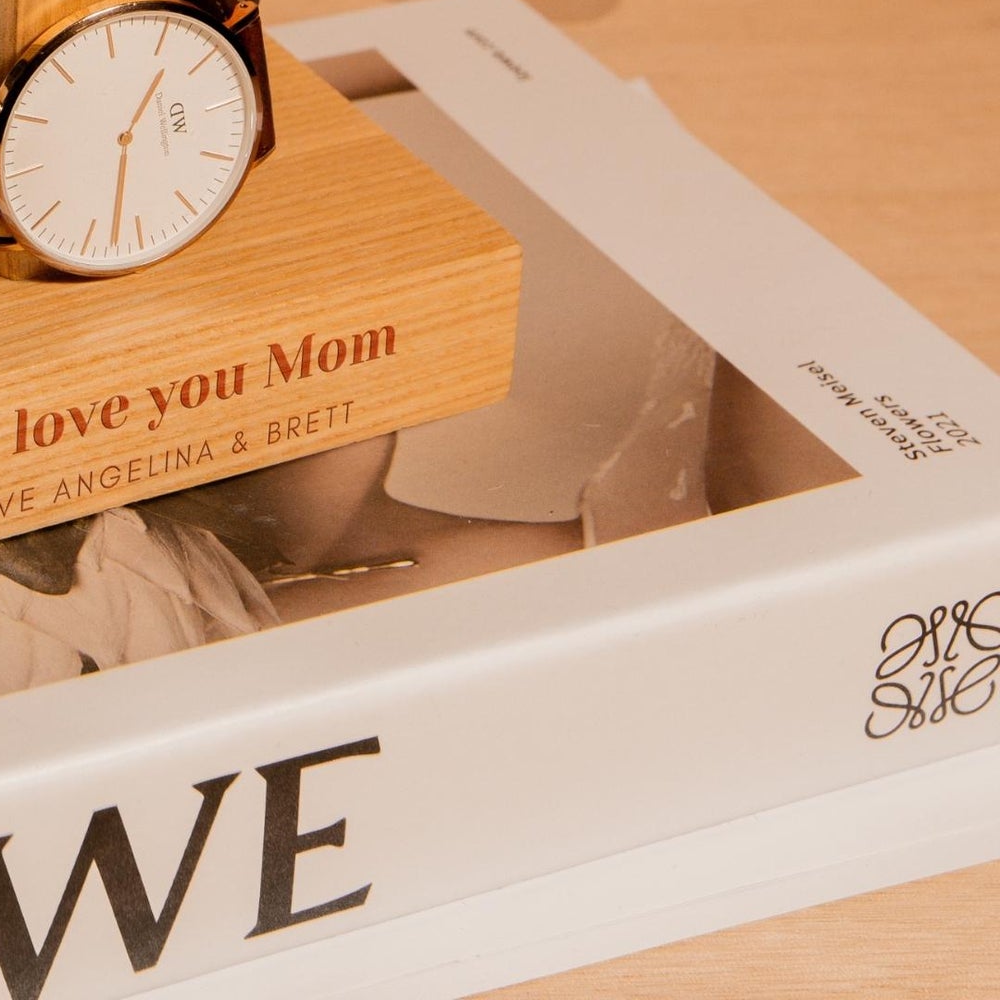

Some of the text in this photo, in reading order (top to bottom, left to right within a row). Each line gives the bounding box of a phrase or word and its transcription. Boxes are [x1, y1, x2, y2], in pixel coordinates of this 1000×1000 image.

[169, 102, 187, 133] DW
[11, 393, 131, 456] love
[146, 362, 249, 431] you
[263, 324, 398, 390] Mom
[797, 360, 928, 461] Steven Meisel
[873, 393, 953, 454] Flowers
[926, 410, 982, 447] 2021
[53, 439, 214, 504] ANGELINA
[231, 430, 249, 455] &
[267, 400, 355, 446] BRETT
